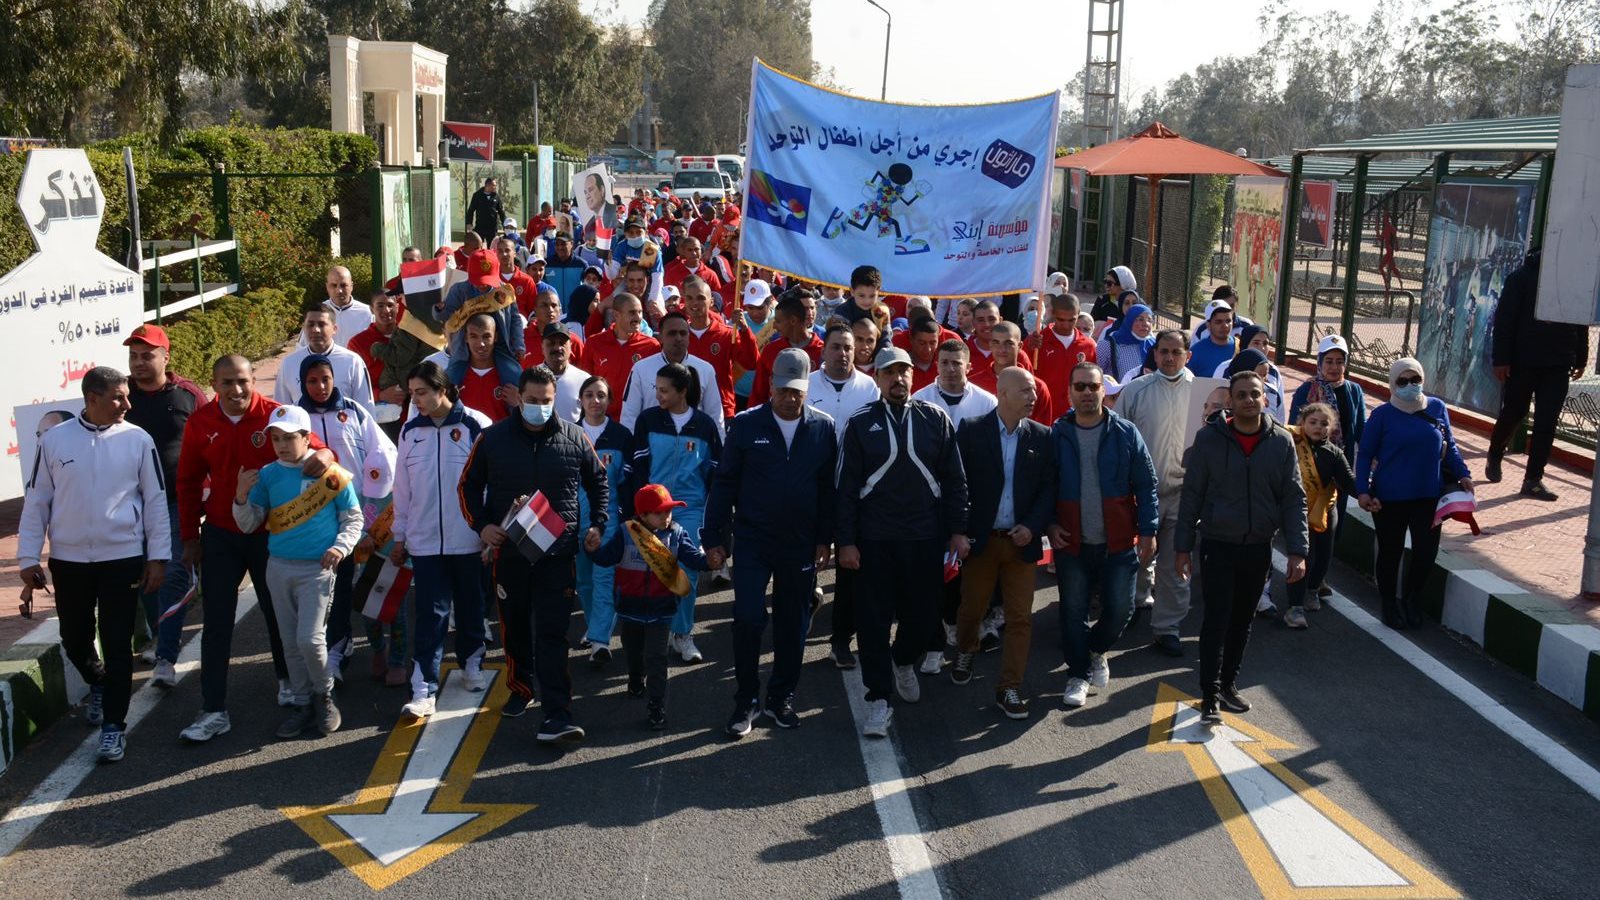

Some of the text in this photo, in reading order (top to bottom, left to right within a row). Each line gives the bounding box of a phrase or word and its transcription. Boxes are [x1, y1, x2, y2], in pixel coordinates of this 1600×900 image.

[818, 126, 863, 151] أطفال
[870, 130, 902, 156] أجل
[907, 136, 930, 160] من
[934, 144, 980, 170] إجري
[985, 142, 1030, 178] ماراتون
[34, 169, 98, 233] تذكر
[978, 247, 1004, 257] الخاصة
[50, 284, 76, 306] الفرد
[79, 280, 107, 302] تقييم
[110, 277, 134, 295] قاعدة
[95, 317, 120, 336] قاعدة
